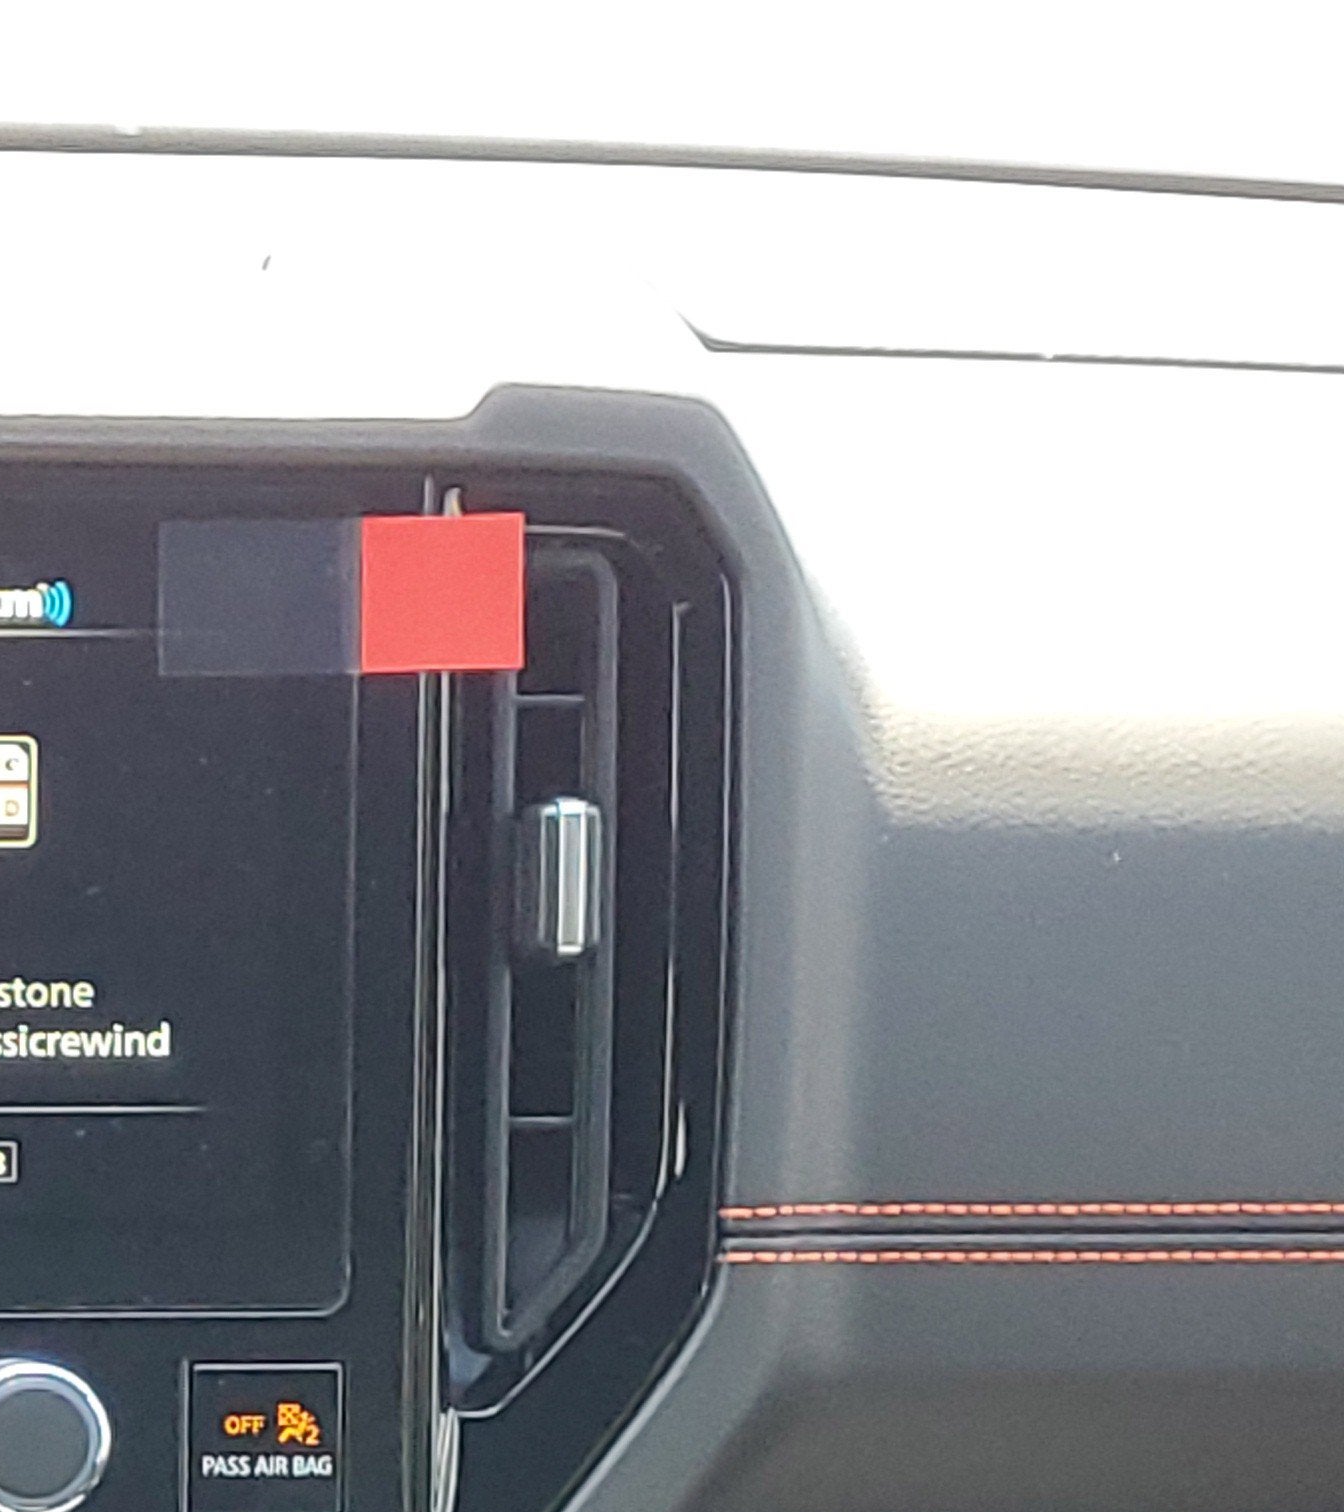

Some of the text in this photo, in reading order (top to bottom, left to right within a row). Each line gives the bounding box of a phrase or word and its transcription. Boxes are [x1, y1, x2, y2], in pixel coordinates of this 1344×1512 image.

[223, 1414, 267, 1437] OFF
[201, 1454, 333, 1478] PASS AIR BAG
